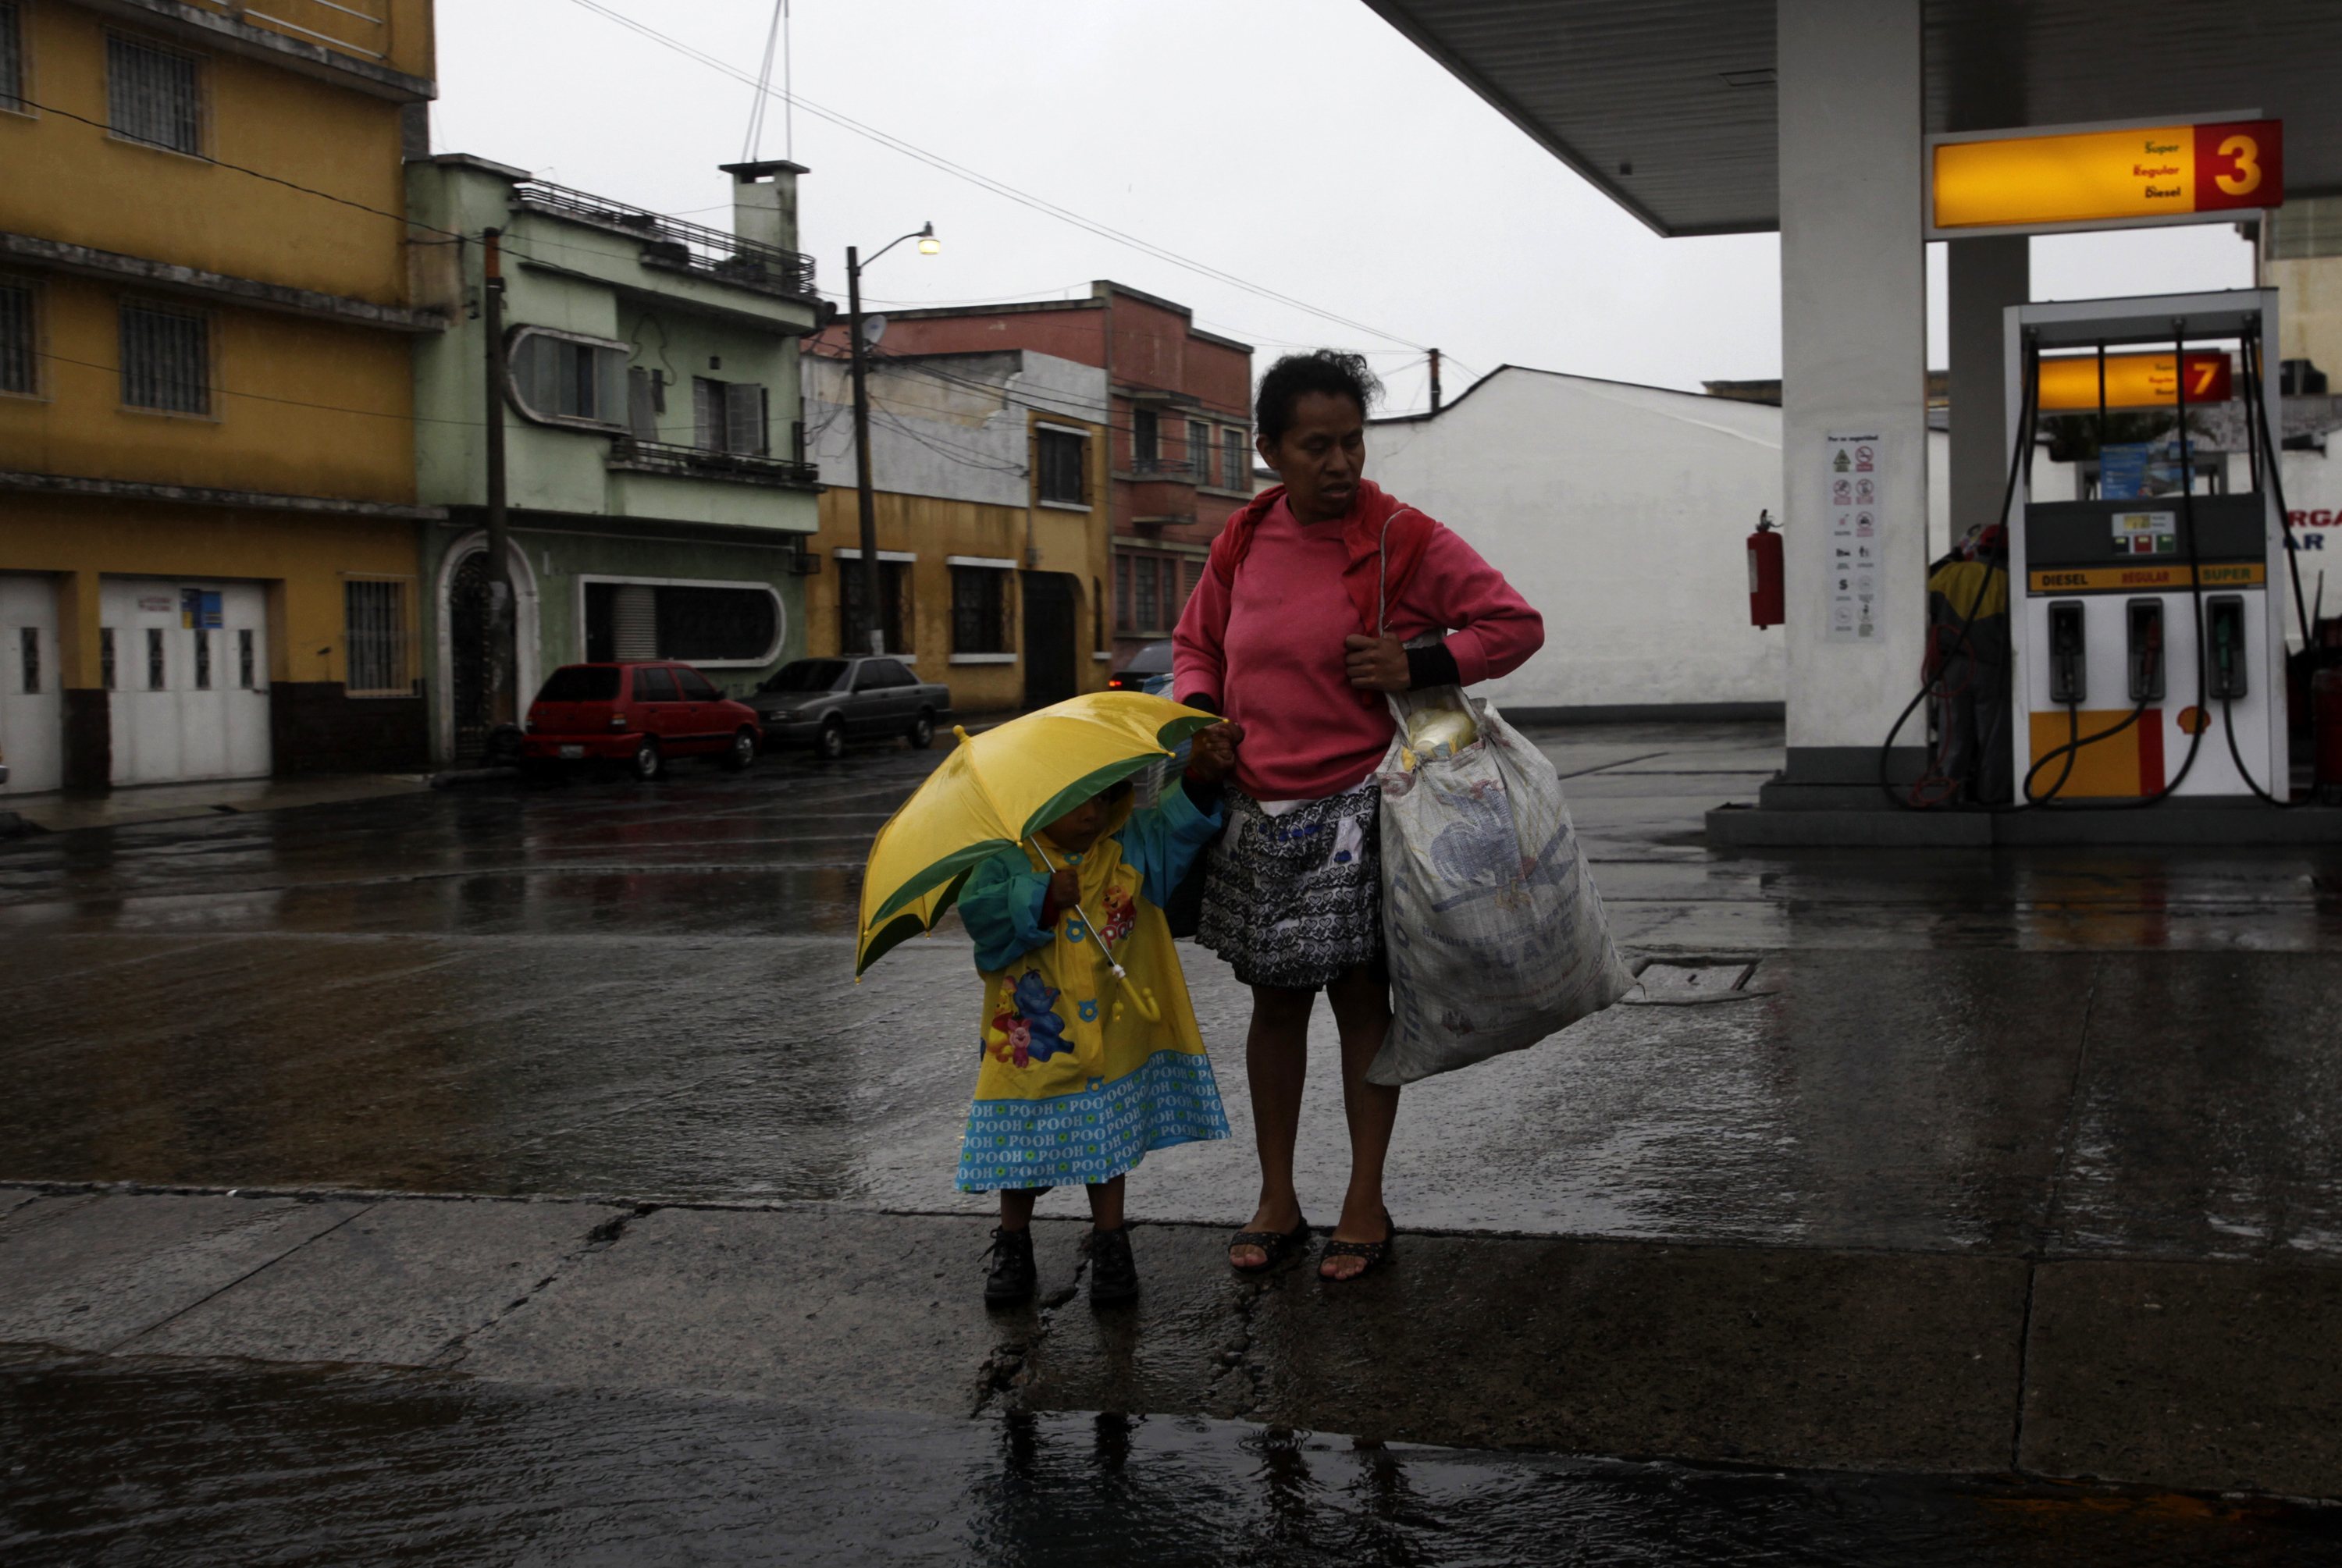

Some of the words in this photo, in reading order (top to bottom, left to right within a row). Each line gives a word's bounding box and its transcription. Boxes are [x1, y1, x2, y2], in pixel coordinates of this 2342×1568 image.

[2144, 141, 2179, 155] Super
[2215, 135, 2262, 195] 3
[2134, 165, 2180, 178] Regular
[2145, 186, 2181, 198] Diesel
[2193, 363, 2219, 395] 7
[2042, 574, 2088, 586] DIESEL
[2122, 571, 2169, 584] REGULAR
[2202, 568, 2251, 581] SUPER
[976, 1119, 1022, 1133] POOH
[1037, 1115, 1083, 1131] POOH
[1181, 1082, 1215, 1097] POOH
[1009, 1103, 1053, 1118] POOH
[1152, 1066, 1187, 1081] POOH
[976, 1150, 1022, 1164] POOH
[1038, 1145, 1084, 1162] POOH
[1187, 1111, 1219, 1126] POOH
[1009, 1134, 1055, 1147] POOH
[1106, 1107, 1141, 1135] POOH
[1156, 1095, 1194, 1109] POOH
[1009, 1164, 1055, 1177] POOH
[1161, 1124, 1198, 1137] POOH
[976, 1180, 1022, 1190] POOH
[1038, 1175, 1084, 1187] POOH
